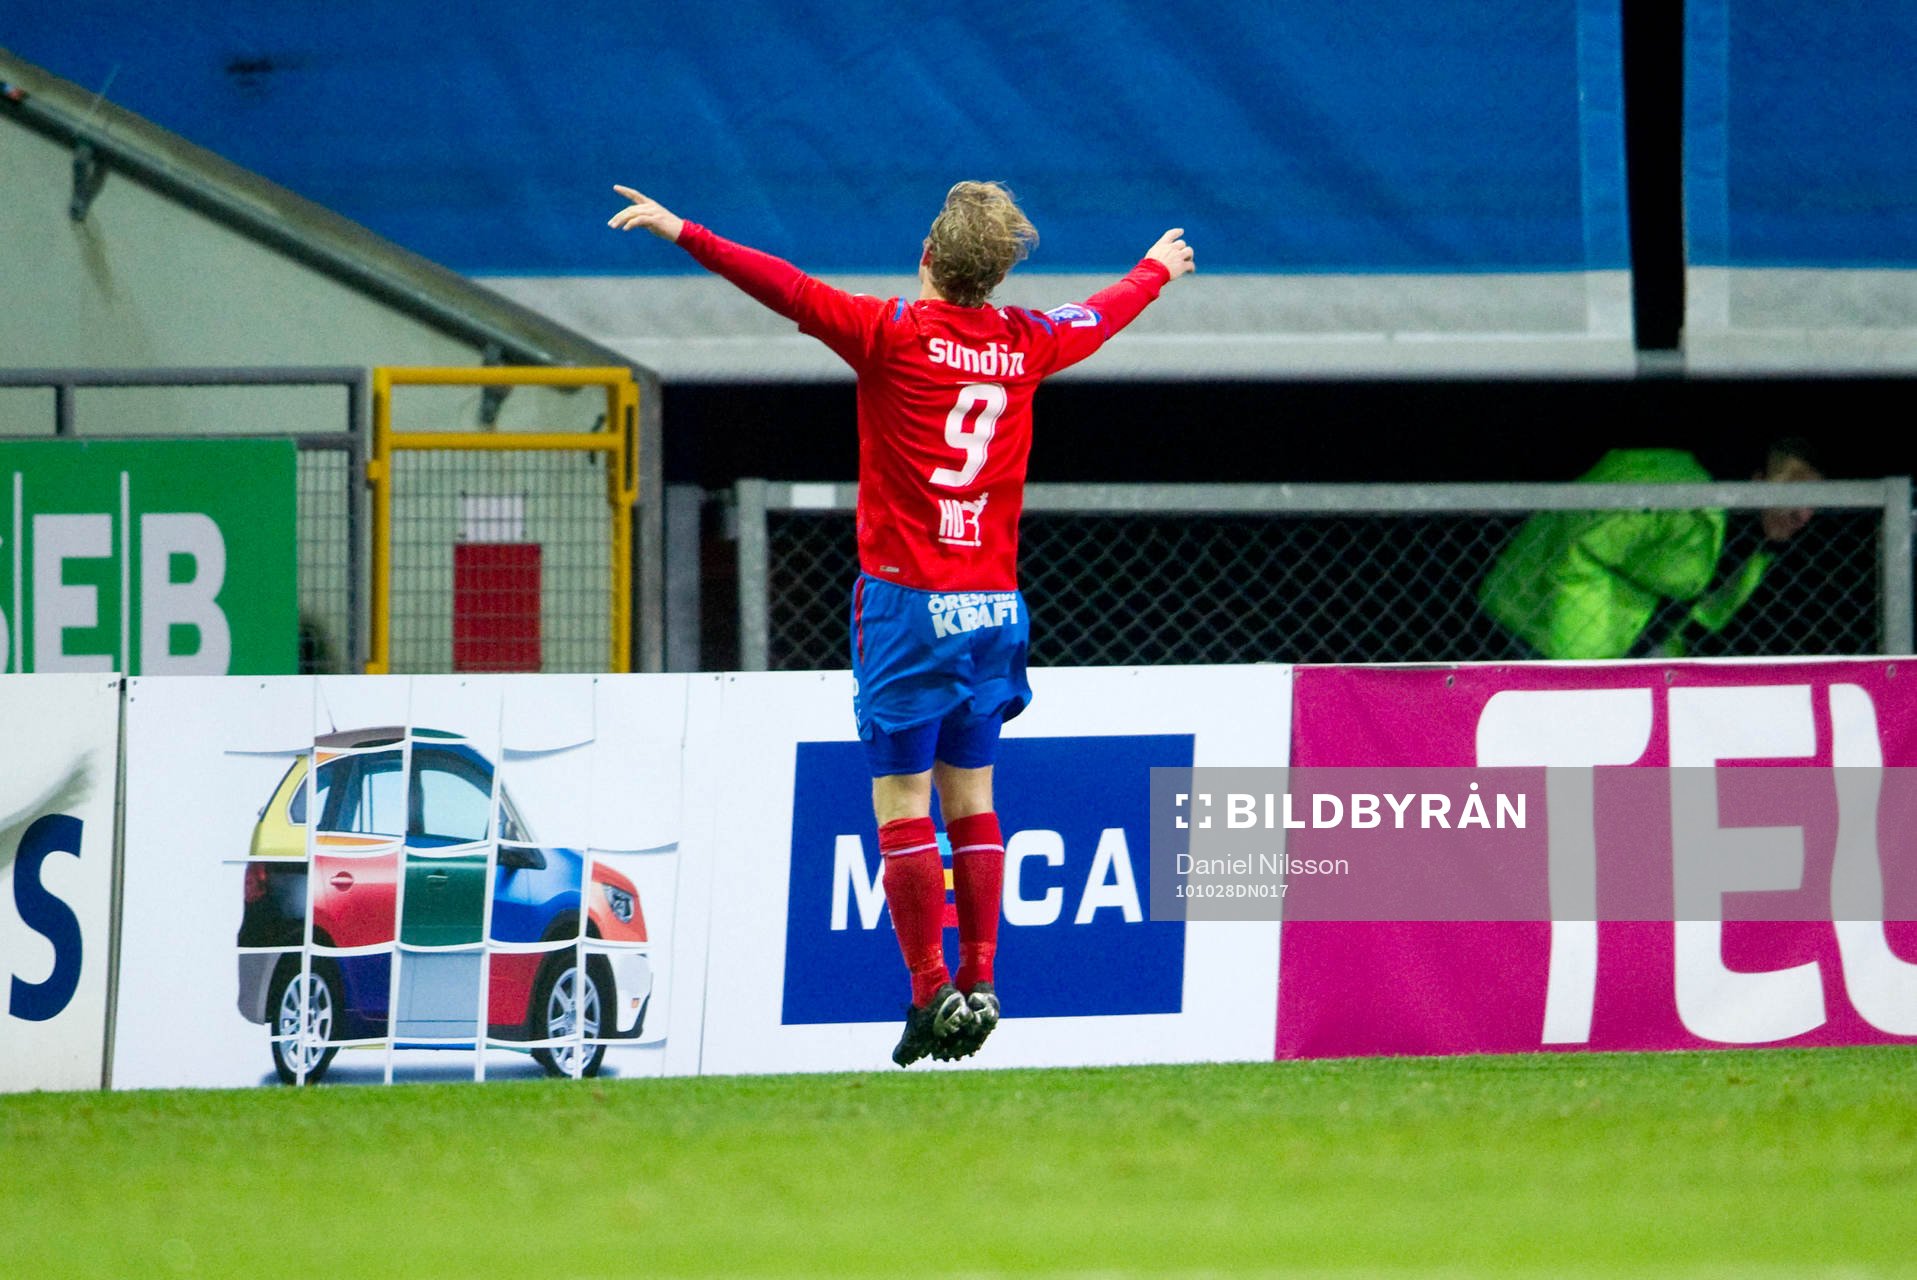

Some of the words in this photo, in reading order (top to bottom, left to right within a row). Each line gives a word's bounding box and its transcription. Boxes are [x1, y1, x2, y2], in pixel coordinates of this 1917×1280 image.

[928, 382, 1007, 488] 9
[0, 512, 232, 676] EB
[931, 600, 1018, 639] KRAFT
